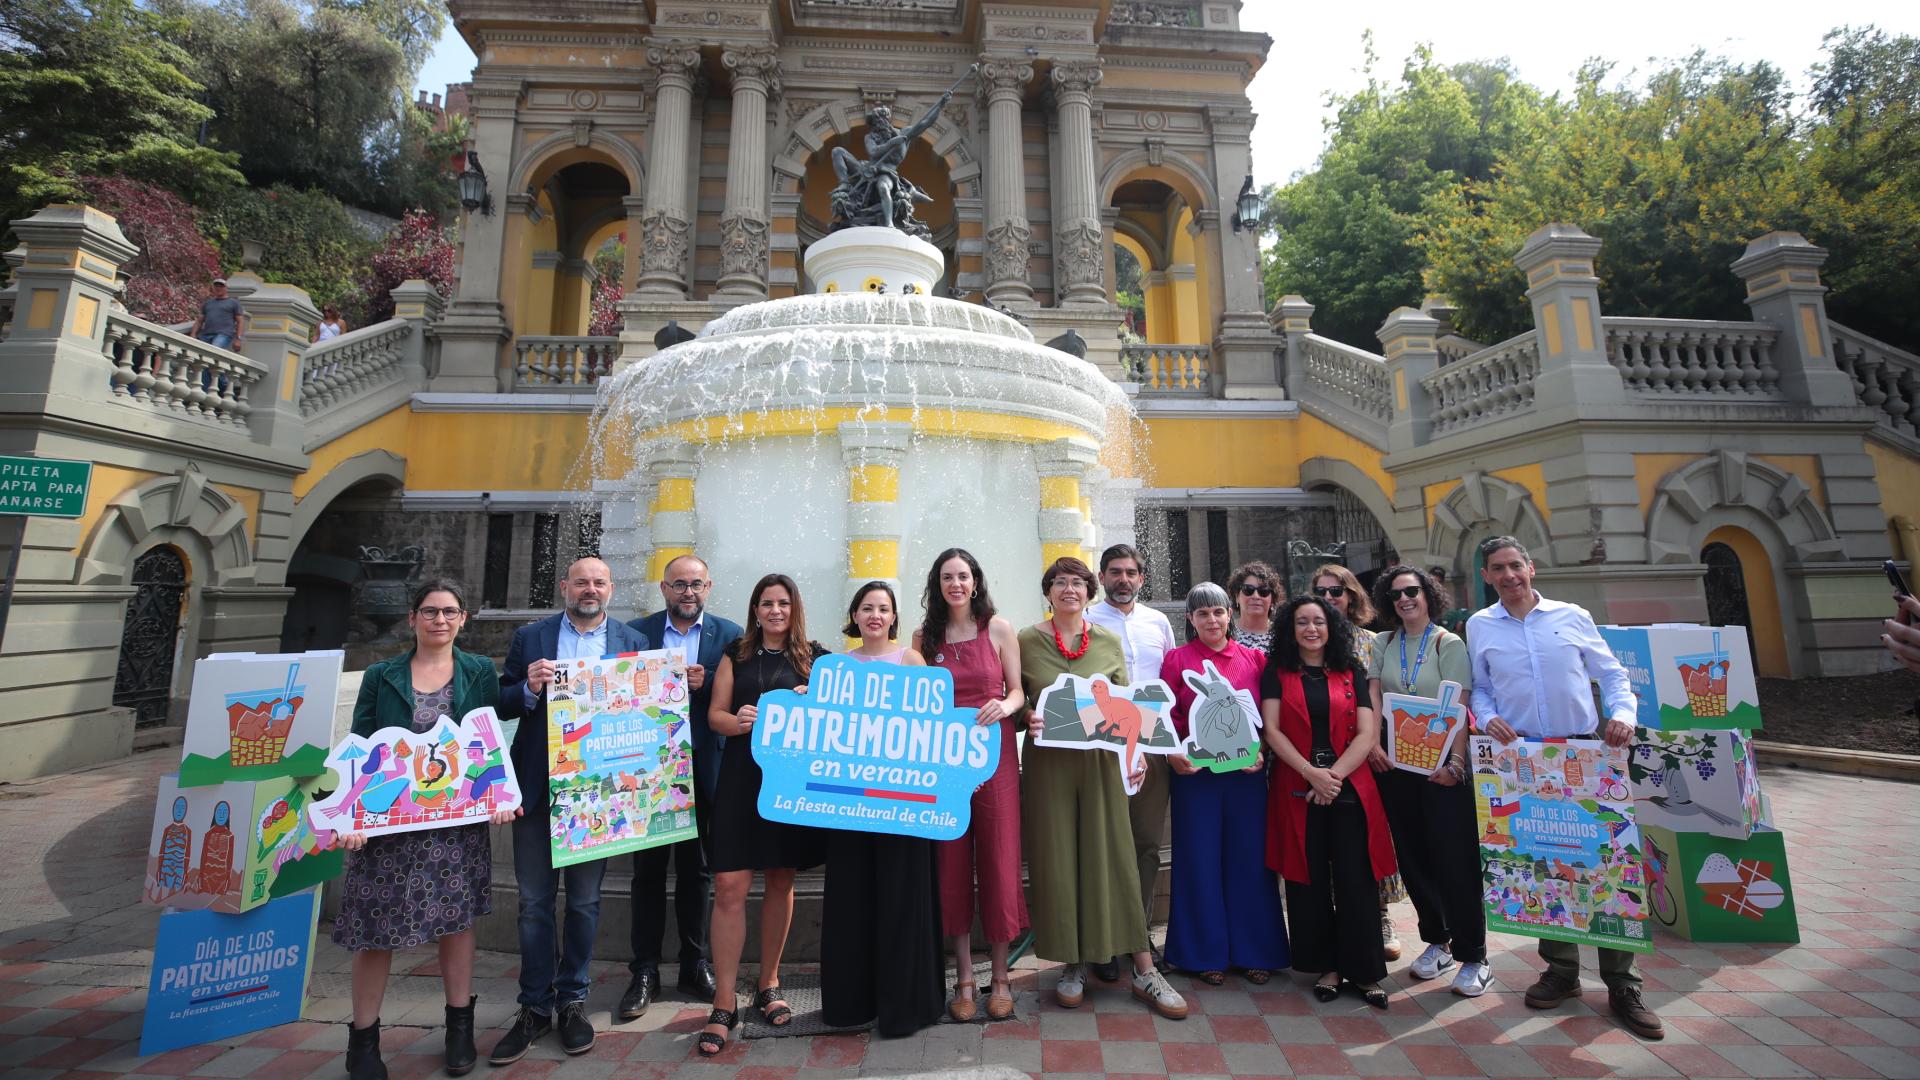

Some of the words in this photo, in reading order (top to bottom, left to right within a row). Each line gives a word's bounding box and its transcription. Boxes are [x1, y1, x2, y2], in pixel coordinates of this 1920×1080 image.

[2, 464, 60, 478] PILETA
[0, 480, 37, 492] APTA
[47, 482, 83, 495] PARA
[0, 495, 64, 509] AÑARSE
[554, 670, 569, 684] 31
[816, 662, 855, 706] DÍA
[863, 672, 895, 710] DE
[902, 676, 946, 715] LOS
[601, 721, 614, 735] DÍA
[617, 720, 627, 733] DE
[629, 718, 643, 731] LOS
[1478, 745, 1493, 758] 31
[809, 759, 841, 778] en
[847, 763, 938, 787] verano
[774, 795, 793, 810] La
[793, 797, 836, 815] fiesta
[839, 803, 896, 821] cultural
[899, 808, 916, 823] de
[919, 809, 958, 827] Chile
[1530, 804, 1546, 818] DÍA
[1548, 807, 1560, 820] DE
[1561, 808, 1578, 822] LOS
[1548, 835, 1581, 844] verano
[195, 936, 219, 961] DÍA
[225, 935, 243, 958] DE
[249, 930, 275, 952] LOS
[191, 984, 211, 997] en
[216, 974, 269, 993] verano
[170, 1011, 181, 1019] La
[182, 1006, 209, 1018] fiesta
[210, 998, 245, 1012] cultural
[246, 995, 257, 1003] de
[258, 990, 281, 1001] Chile
